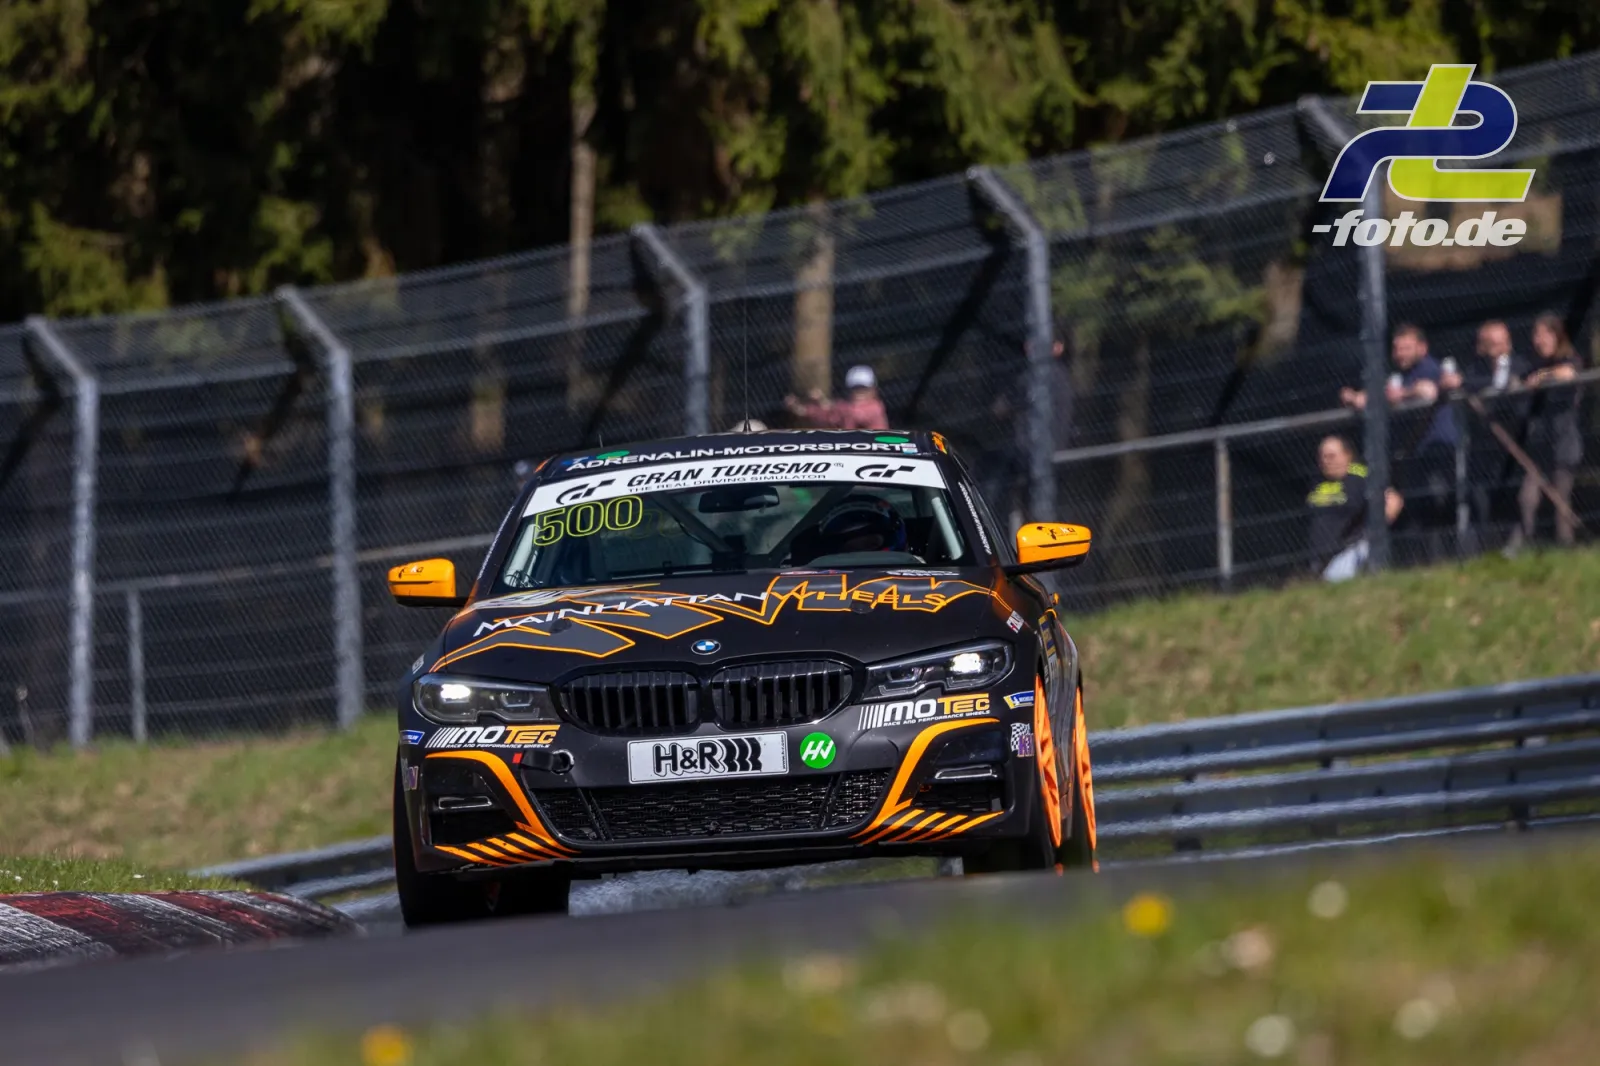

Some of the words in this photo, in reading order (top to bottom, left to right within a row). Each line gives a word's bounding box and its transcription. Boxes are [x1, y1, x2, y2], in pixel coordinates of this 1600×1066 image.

[627, 467, 703, 487] GRAN
[656, 483, 689, 491] REAL
[693, 477, 747, 485] DRIVING
[533, 495, 643, 546] 500
[472, 591, 768, 637] MAINHATTAN
[918, 713, 964, 723] PERFORMANCE
[653, 740, 724, 776] H&R
